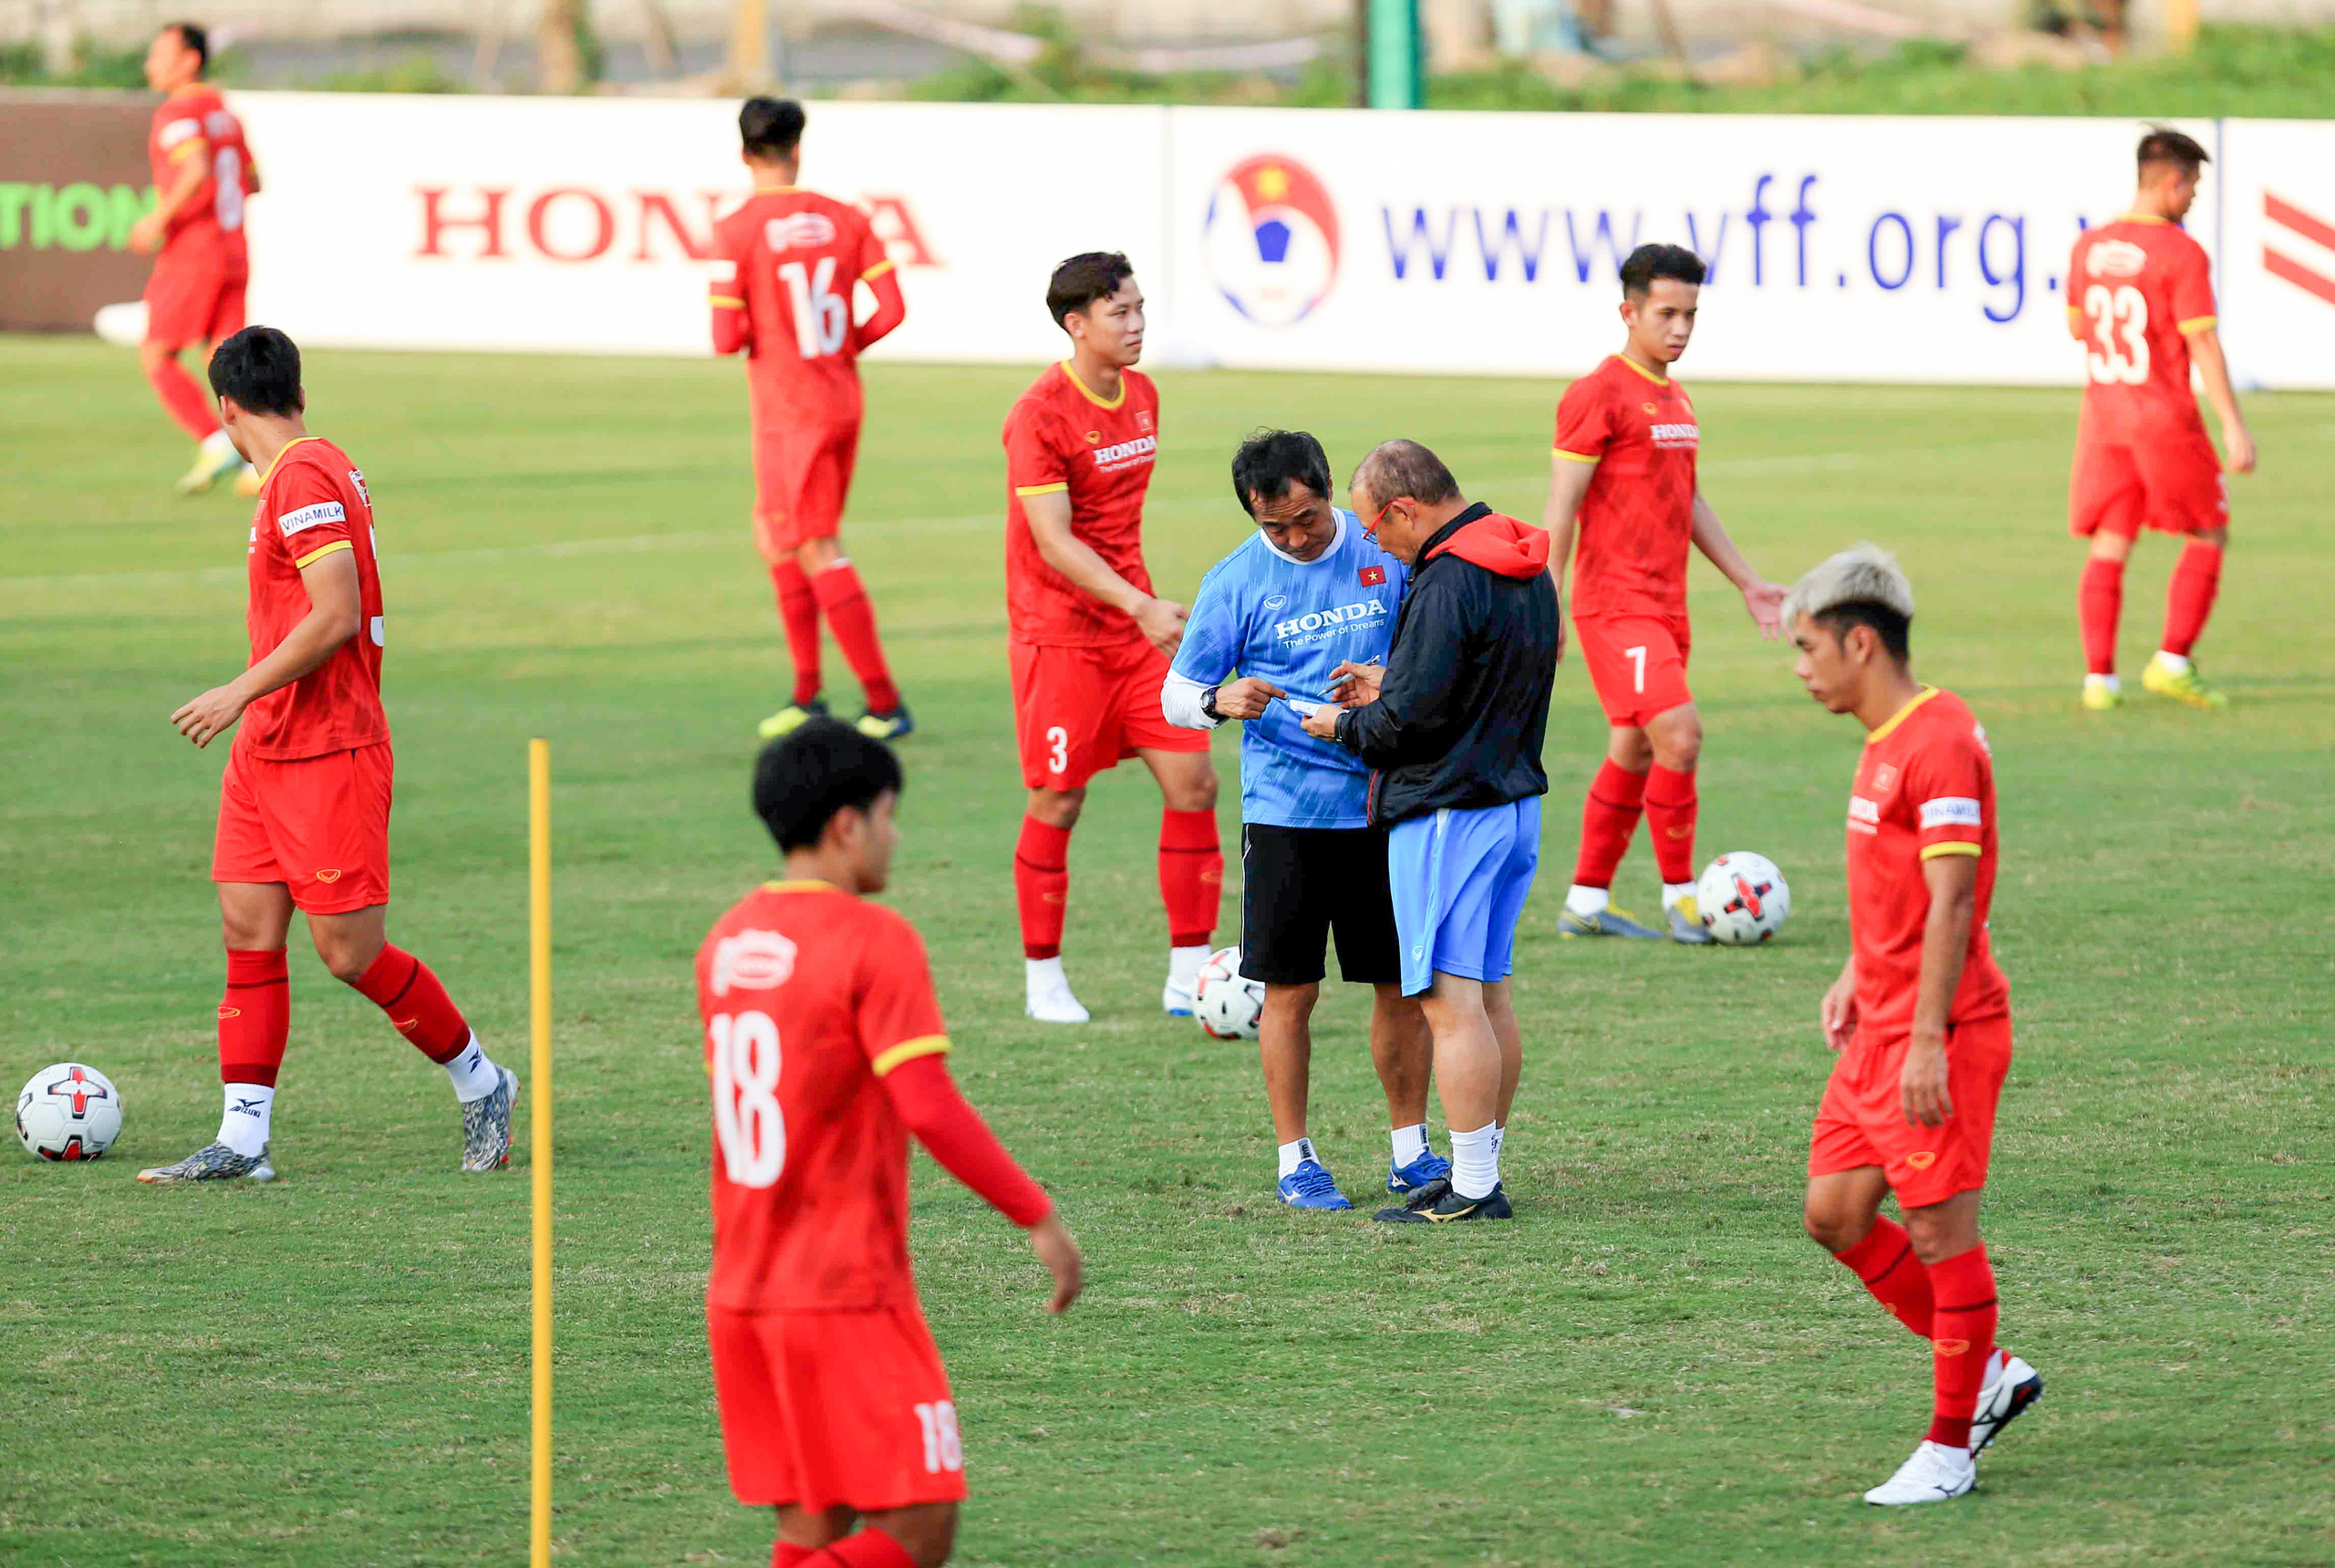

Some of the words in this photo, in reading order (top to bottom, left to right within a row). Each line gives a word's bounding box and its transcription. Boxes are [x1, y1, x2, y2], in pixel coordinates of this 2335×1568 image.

[413, 187, 945, 265] HONA
[778, 256, 846, 359] 16
[2086, 284, 2150, 384] 33
[282, 504, 343, 531] VINAMILK
[1274, 598, 1387, 639] HONDA
[1282, 639, 1304, 649] The
[1304, 628, 1337, 643] Power
[1338, 625, 1350, 636] of
[1351, 618, 1385, 632] Dreams
[1046, 725, 1068, 775] 3
[709, 1010, 786, 1189] 18
[914, 1400, 962, 1473] 18
